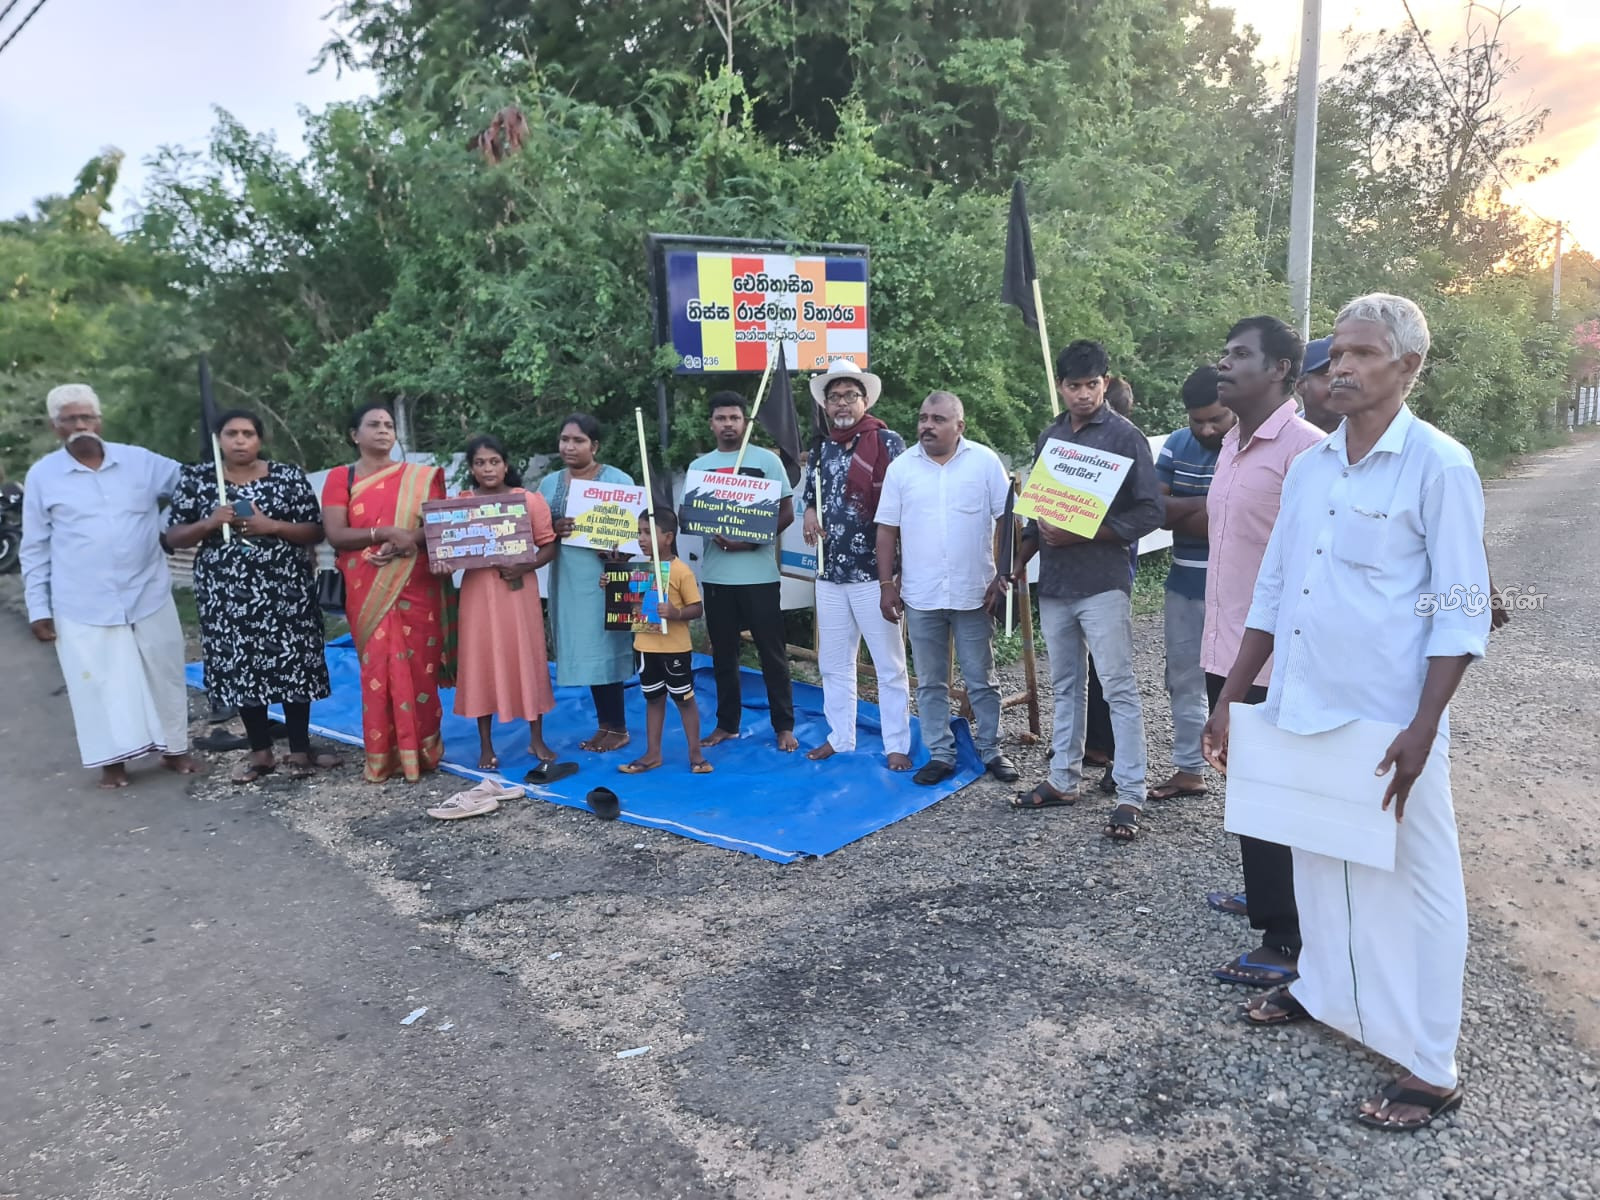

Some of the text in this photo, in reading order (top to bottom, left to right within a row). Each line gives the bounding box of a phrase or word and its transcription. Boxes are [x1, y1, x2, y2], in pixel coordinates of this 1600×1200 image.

[688, 300, 729, 320] තිස්ස
[803, 301, 854, 321] විහාරය
[703, 356, 719, 366] 236
[1049, 445, 1120, 472] சிறிலங்கா
[1053, 462, 1101, 483] அரசே!
[703, 474, 770, 491] IMMEDIATELY
[583, 487, 643, 506] அரசே!
[714, 489, 756, 502] REMOVE
[692, 499, 774, 518] Illegal Structure
[687, 522, 722, 534] Alleged
[717, 514, 746, 525] of the
